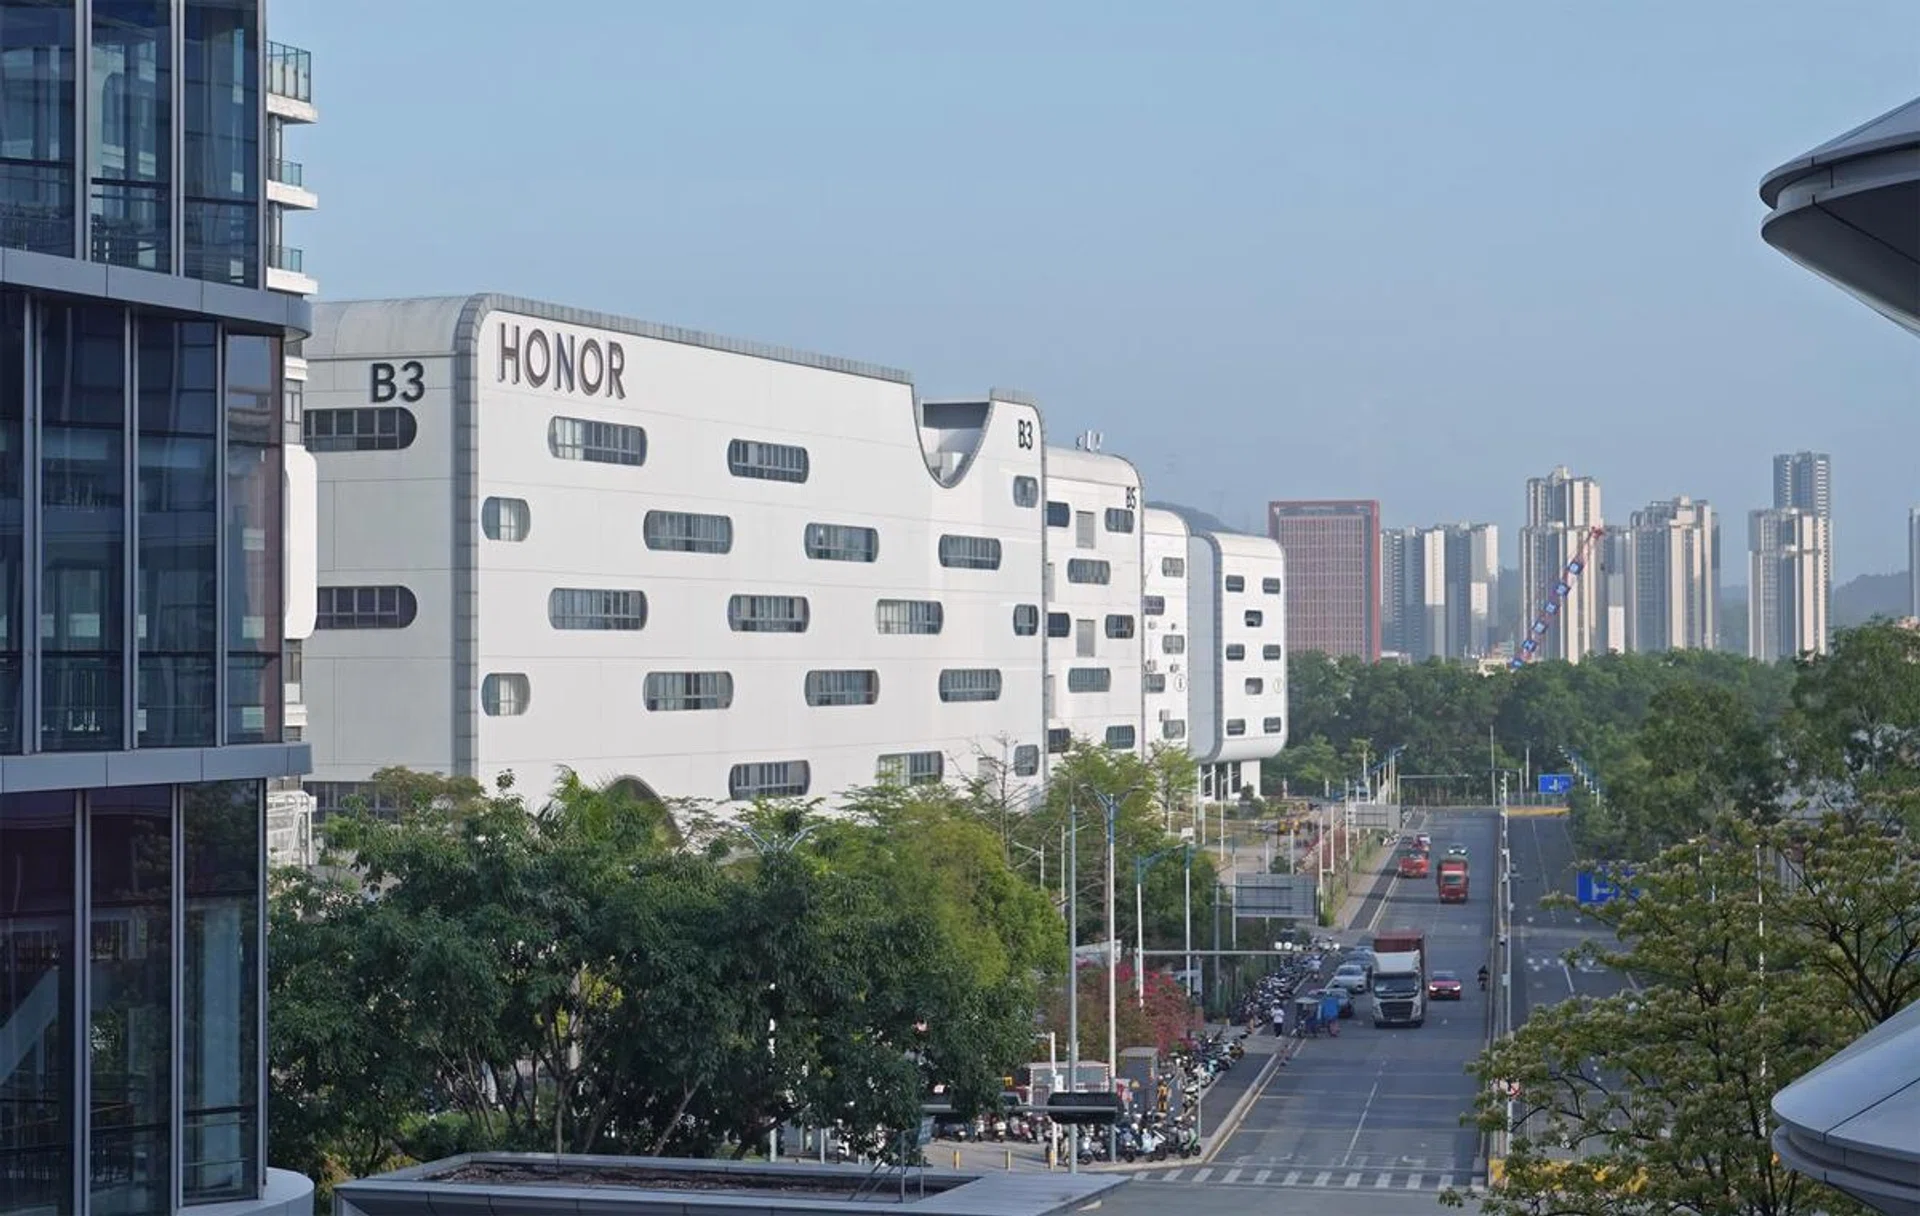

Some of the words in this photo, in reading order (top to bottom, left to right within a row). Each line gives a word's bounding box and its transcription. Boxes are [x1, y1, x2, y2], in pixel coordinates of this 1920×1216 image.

[497, 322, 626, 399] HONOR
[371, 361, 425, 403] B3
[1018, 419, 1033, 450] B3
[1126, 486, 1137, 510] B5
